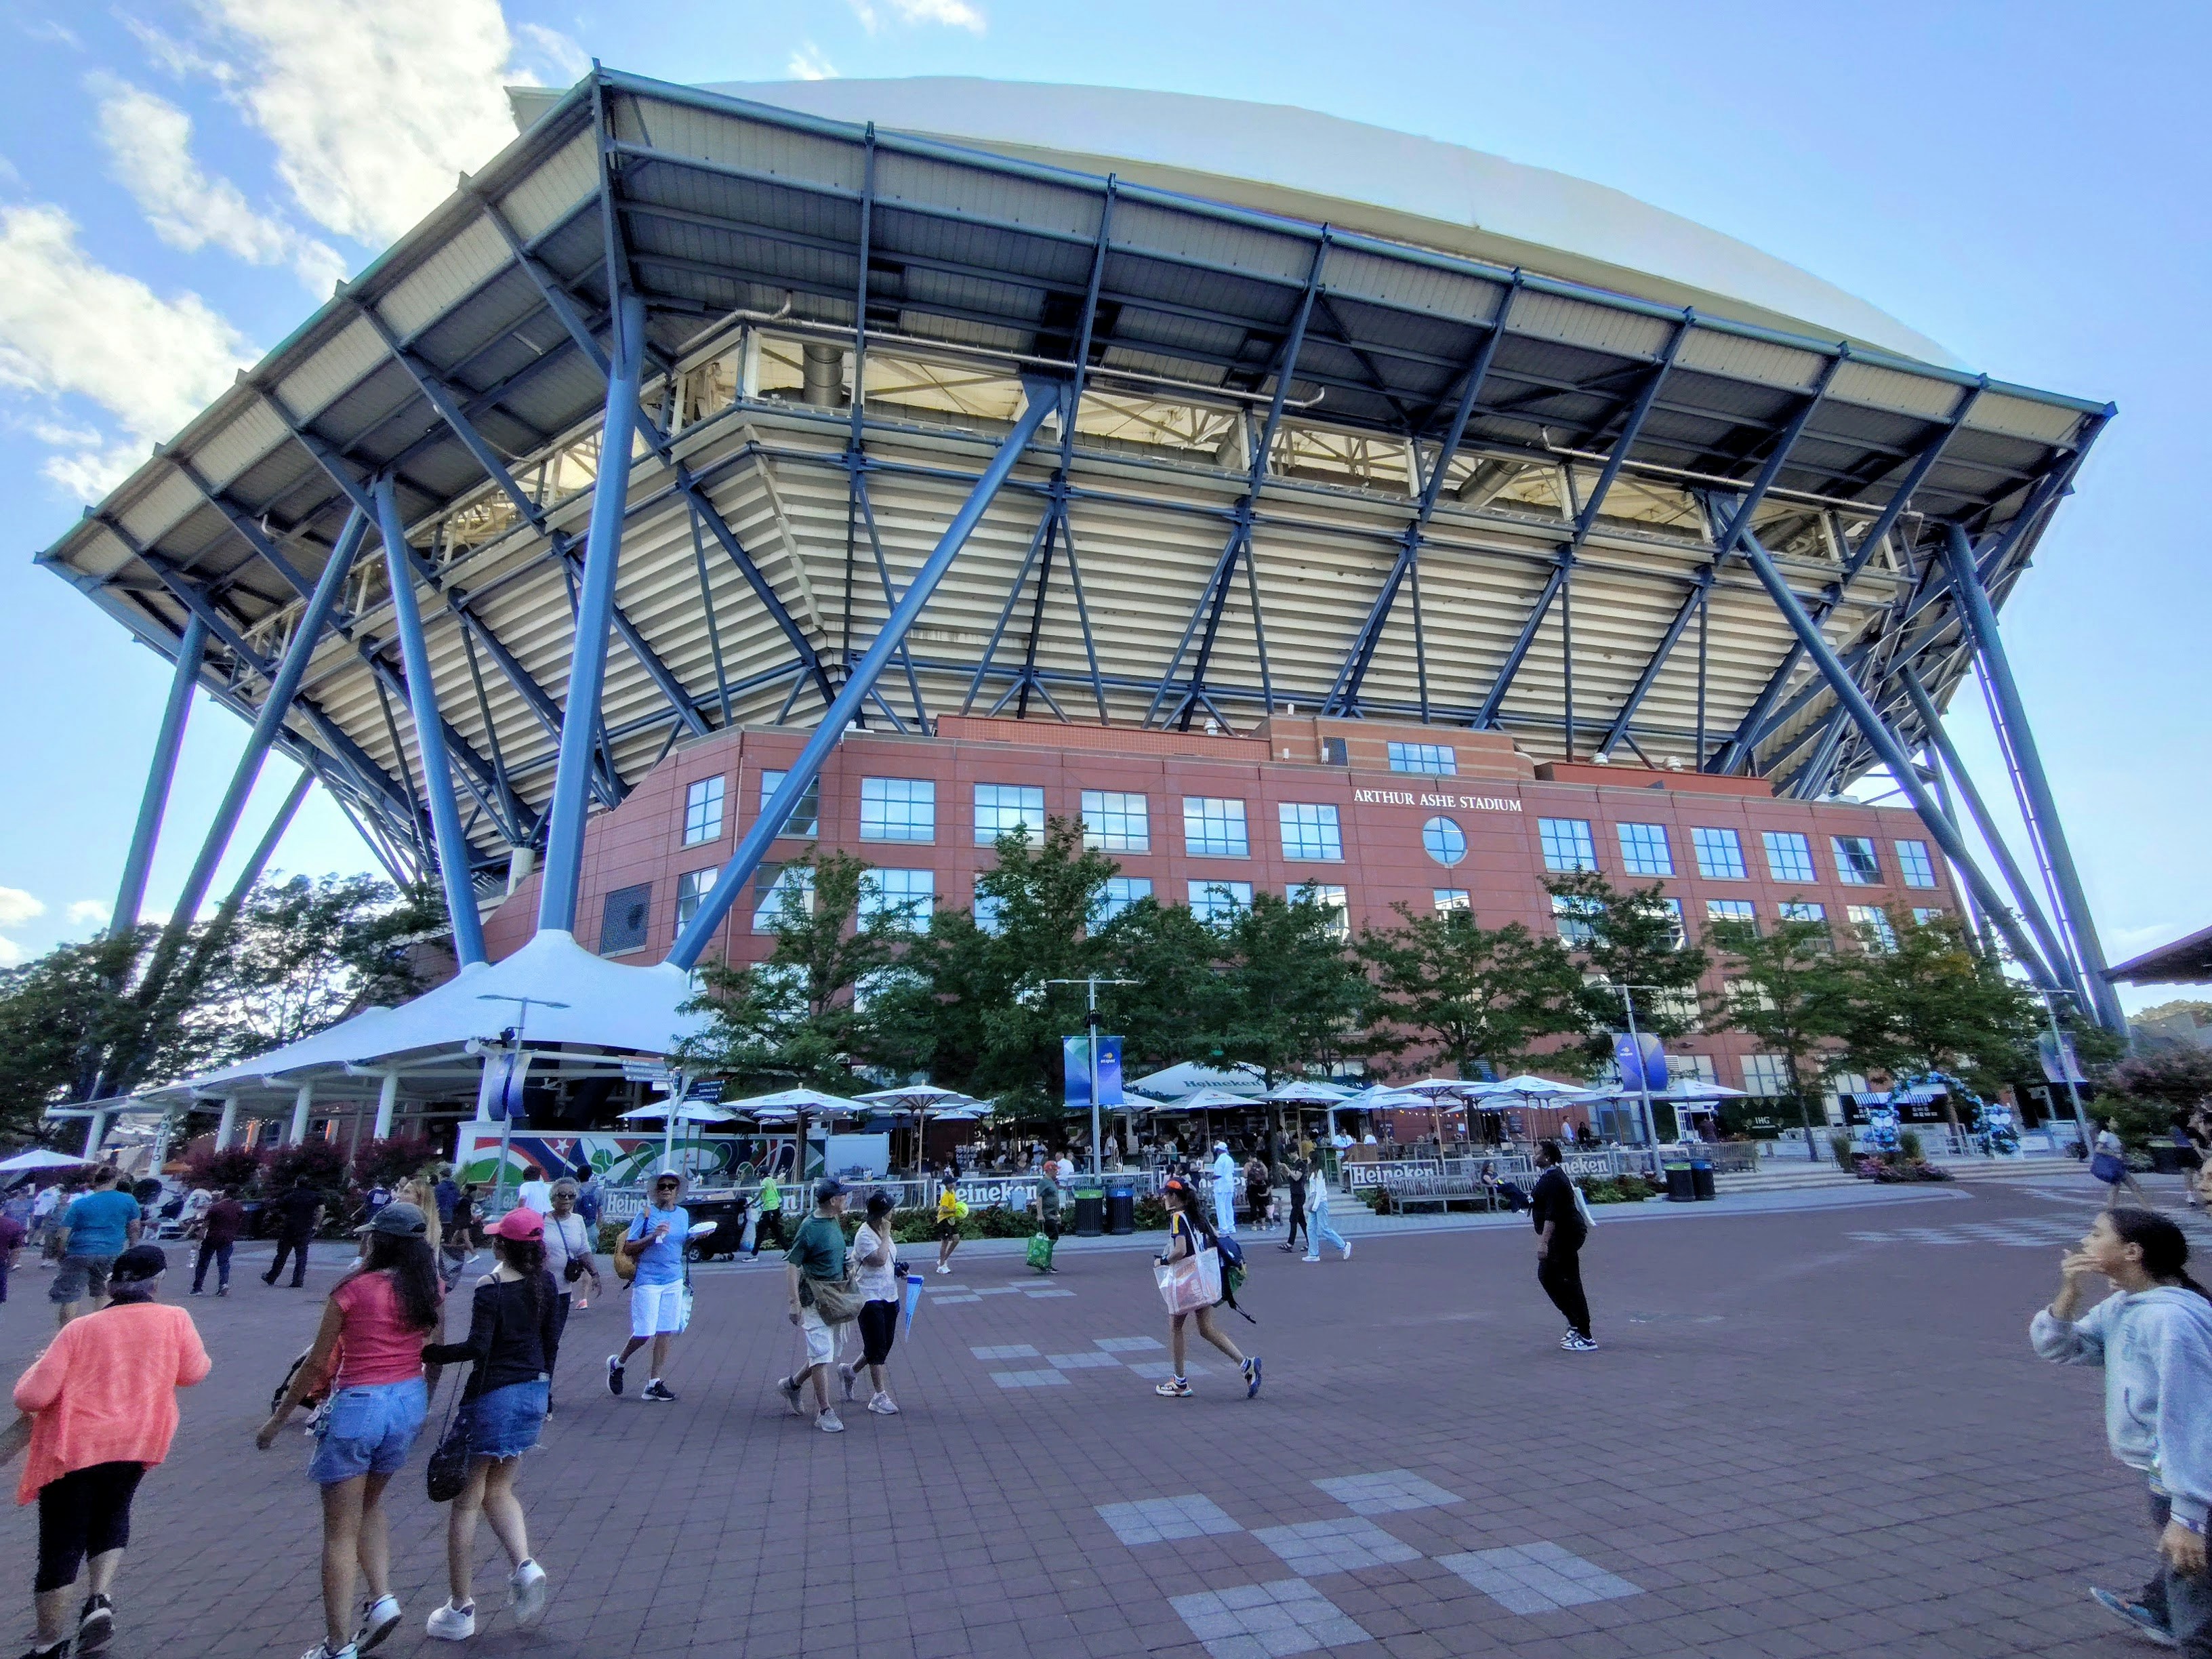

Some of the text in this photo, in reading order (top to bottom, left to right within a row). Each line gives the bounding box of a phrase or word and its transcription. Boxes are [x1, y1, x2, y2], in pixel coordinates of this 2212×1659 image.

[1354, 789, 1522, 811] ARTHUR ASHE STADIUM
[1755, 1116, 1770, 1124] IHG
[1352, 1165, 1434, 1184] Heineken
[939, 1182, 1038, 1203] einekn
